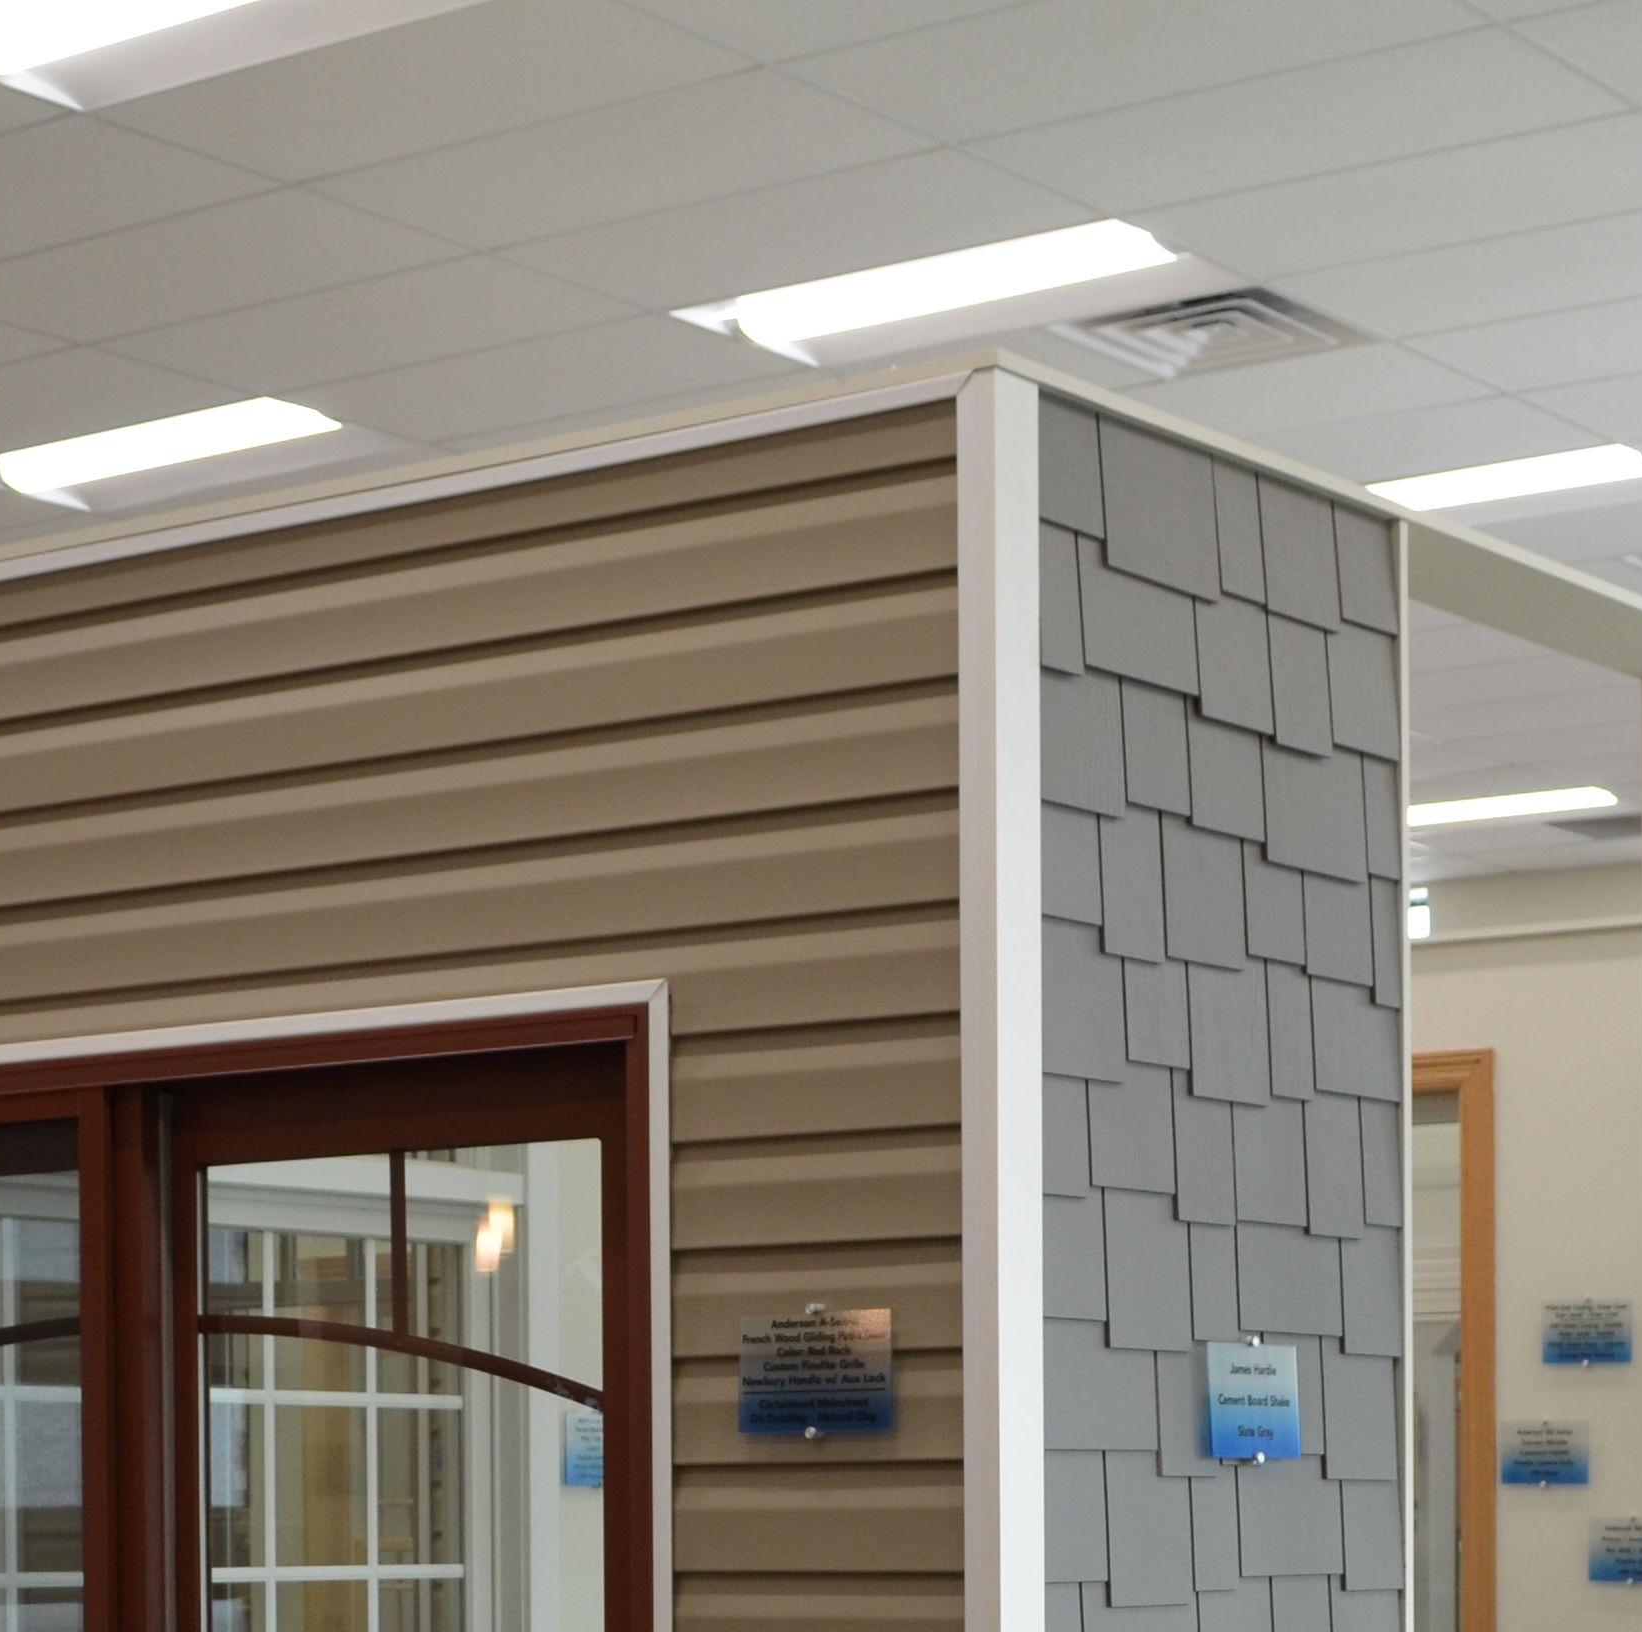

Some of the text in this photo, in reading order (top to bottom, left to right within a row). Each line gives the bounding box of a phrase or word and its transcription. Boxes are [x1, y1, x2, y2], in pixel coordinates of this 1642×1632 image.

[771, 1318, 816, 1329] Anderson
[742, 1333, 772, 1344] French
[774, 1333, 800, 1343] Wood
[803, 1331, 835, 1344] Gliding
[807, 1346, 826, 1356] Red
[828, 1345, 851, 1355] Rock
[763, 1361, 799, 1372] Custom
[1230, 1362, 1277, 1376] James Hardie
[742, 1375, 785, 1388] Newbury
[788, 1374, 821, 1385] Handle
[840, 1373, 860, 1383] Aux
[863, 1372, 886, 1383] Lock
[1218, 1393, 1246, 1406] Cement
[1247, 1394, 1268, 1407] Board
